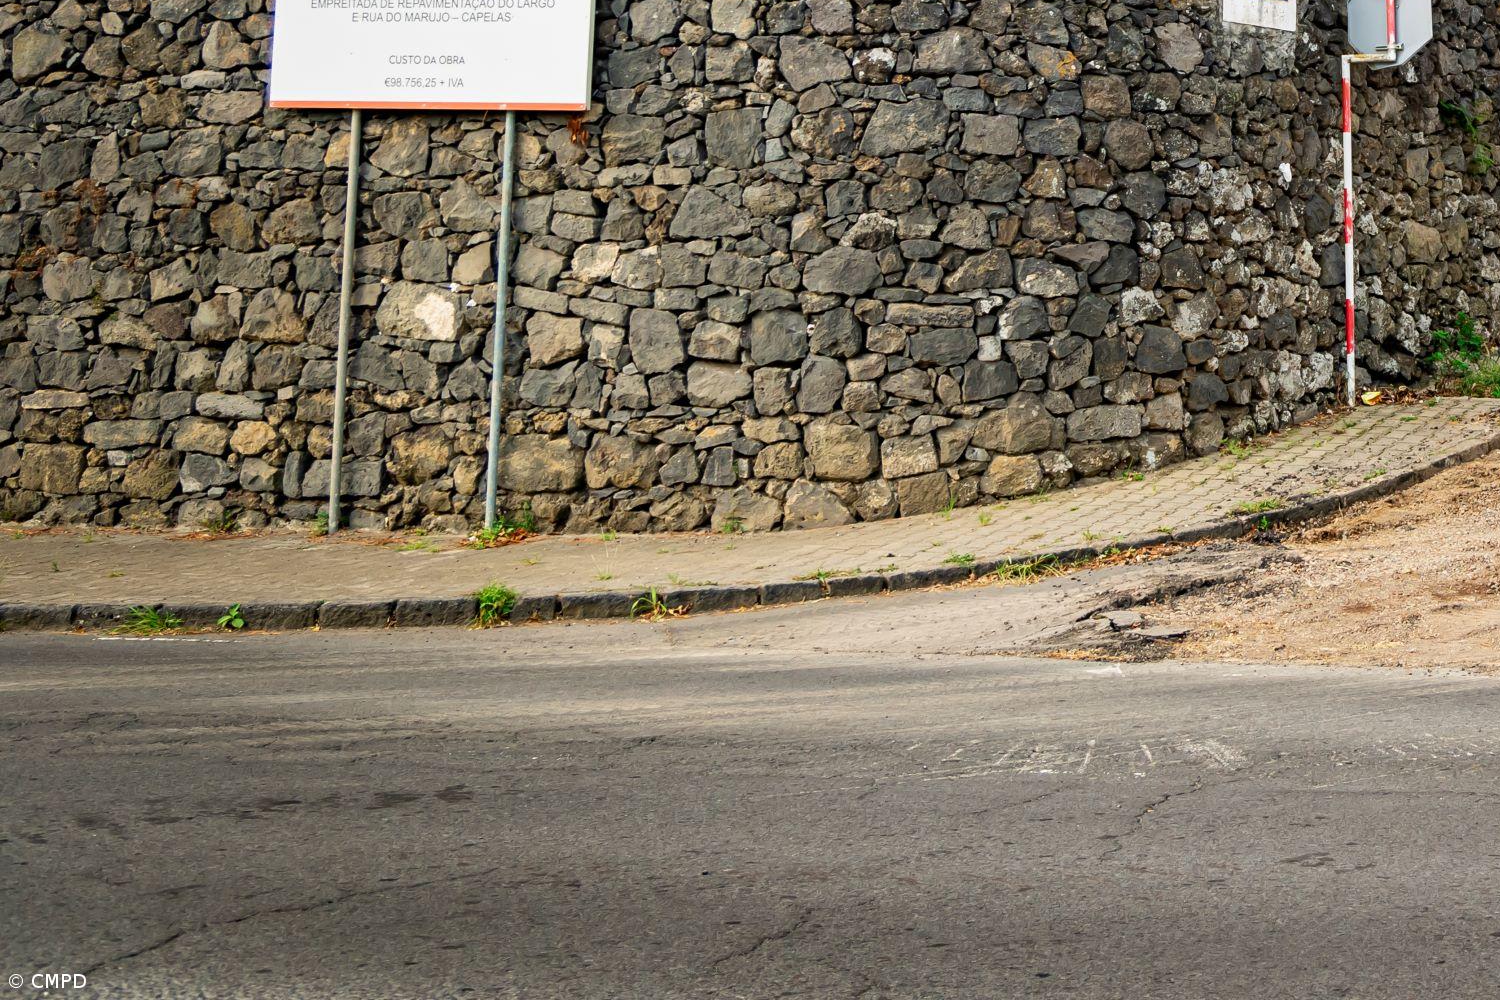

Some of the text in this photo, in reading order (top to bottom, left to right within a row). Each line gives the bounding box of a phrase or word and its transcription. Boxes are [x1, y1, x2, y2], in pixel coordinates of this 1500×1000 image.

[351, 12, 359, 22] E
[362, 12, 384, 22] RUA
[386, 12, 402, 22] DO
[404, 12, 450, 23] MARUJO
[461, 12, 512, 23] CAPELAS
[388, 55, 466, 65] CUSTO DA OBRA
[448, 77, 464, 88] IVA
